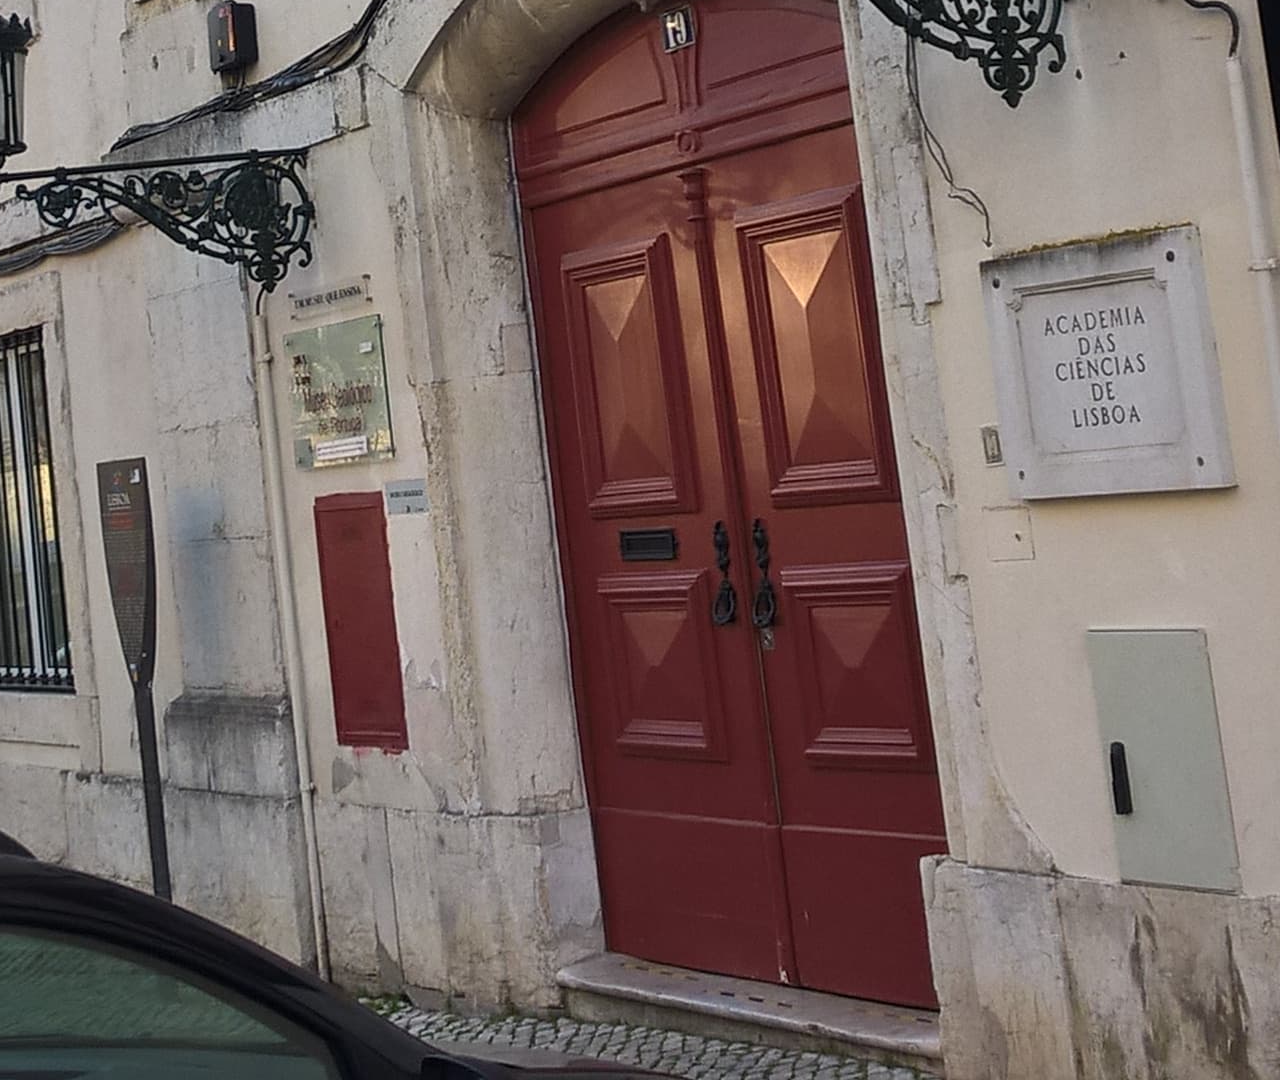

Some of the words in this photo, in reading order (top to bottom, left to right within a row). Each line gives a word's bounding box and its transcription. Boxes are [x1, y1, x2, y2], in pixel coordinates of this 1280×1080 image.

[1045, 306, 1145, 337] ACADEMIA
[1078, 332, 1116, 356] DAS
[1055, 353, 1145, 382] CIÊNCIAS
[1091, 381, 1116, 402] DE
[1072, 404, 1141, 428] LISBOA
